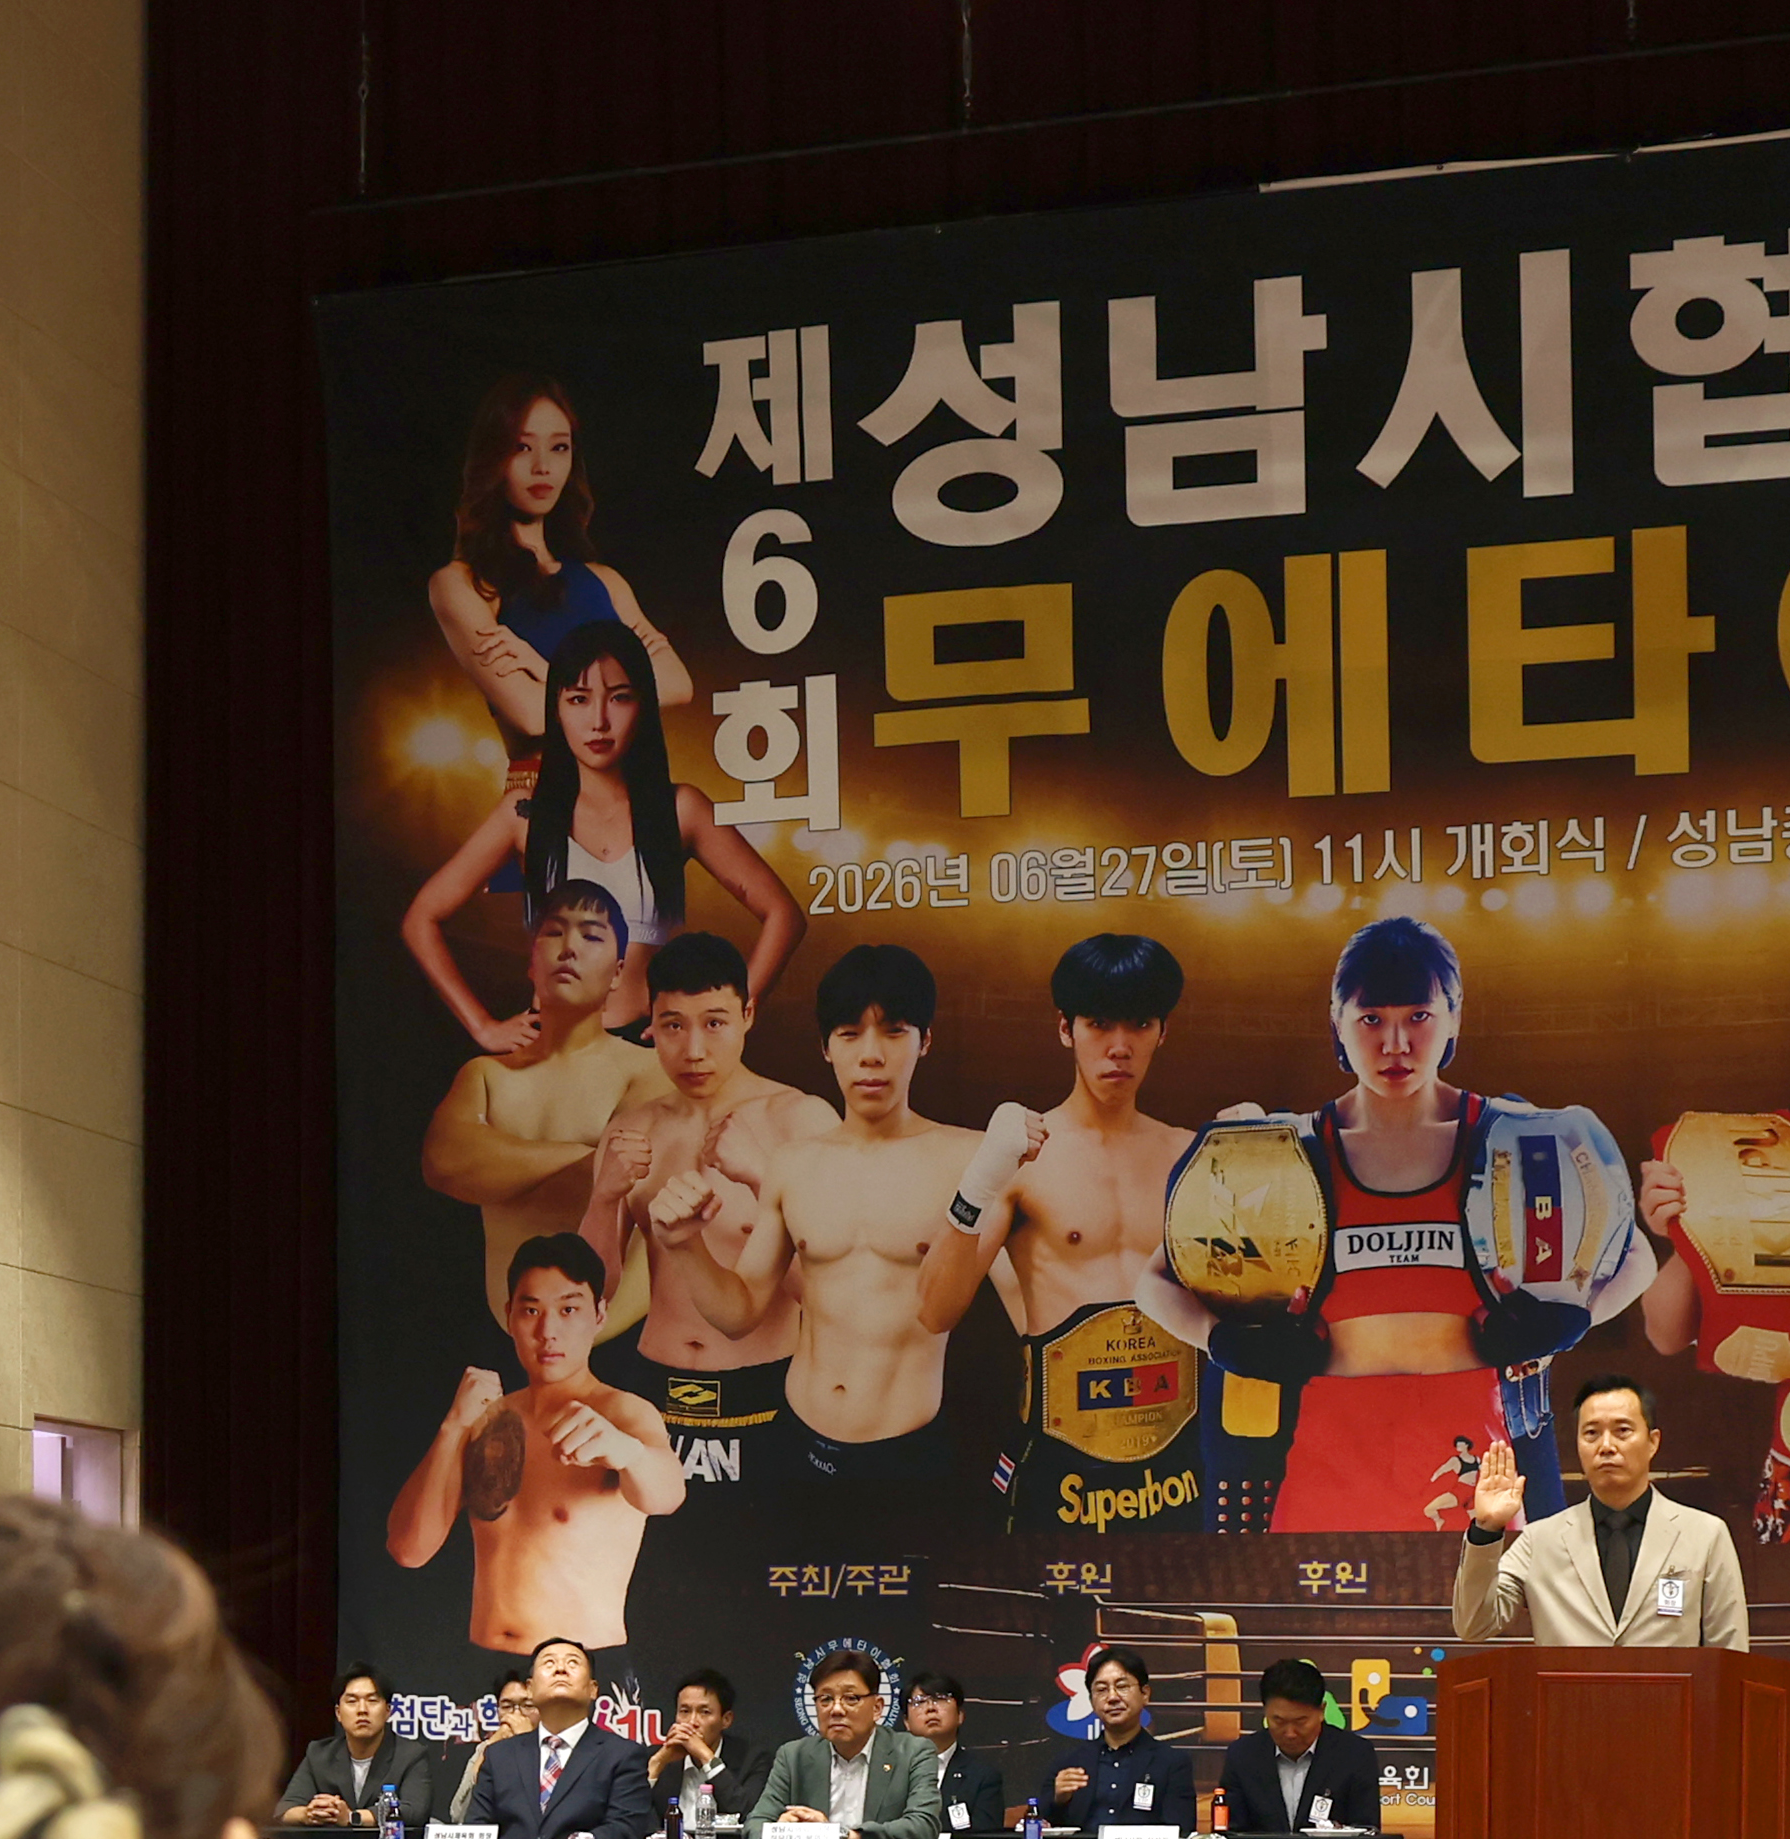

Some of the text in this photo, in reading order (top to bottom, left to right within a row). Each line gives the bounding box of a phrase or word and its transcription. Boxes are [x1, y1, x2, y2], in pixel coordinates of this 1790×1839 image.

[807, 846, 971, 917] 2026년
[989, 834, 1295, 907] 06월27일(토)
[1313, 825, 1424, 892] 11시
[1446, 811, 1609, 882] 개회식
[1347, 1230, 1456, 1256] DOLJJIN
[1389, 1254, 1420, 1264] TEAM
[1106, 1337, 1157, 1352] KOREA
[1088, 1353, 1127, 1366] BOXING
[1088, 1374, 1170, 1400] KBA
[1056, 1468, 1200, 1534] Superbon
[768, 1563, 911, 1600] 주최/주관
[1045, 1562, 1112, 1594] 후원
[1298, 1561, 1367, 1594] 후원
[1378, 1765, 1429, 1790] 육회
